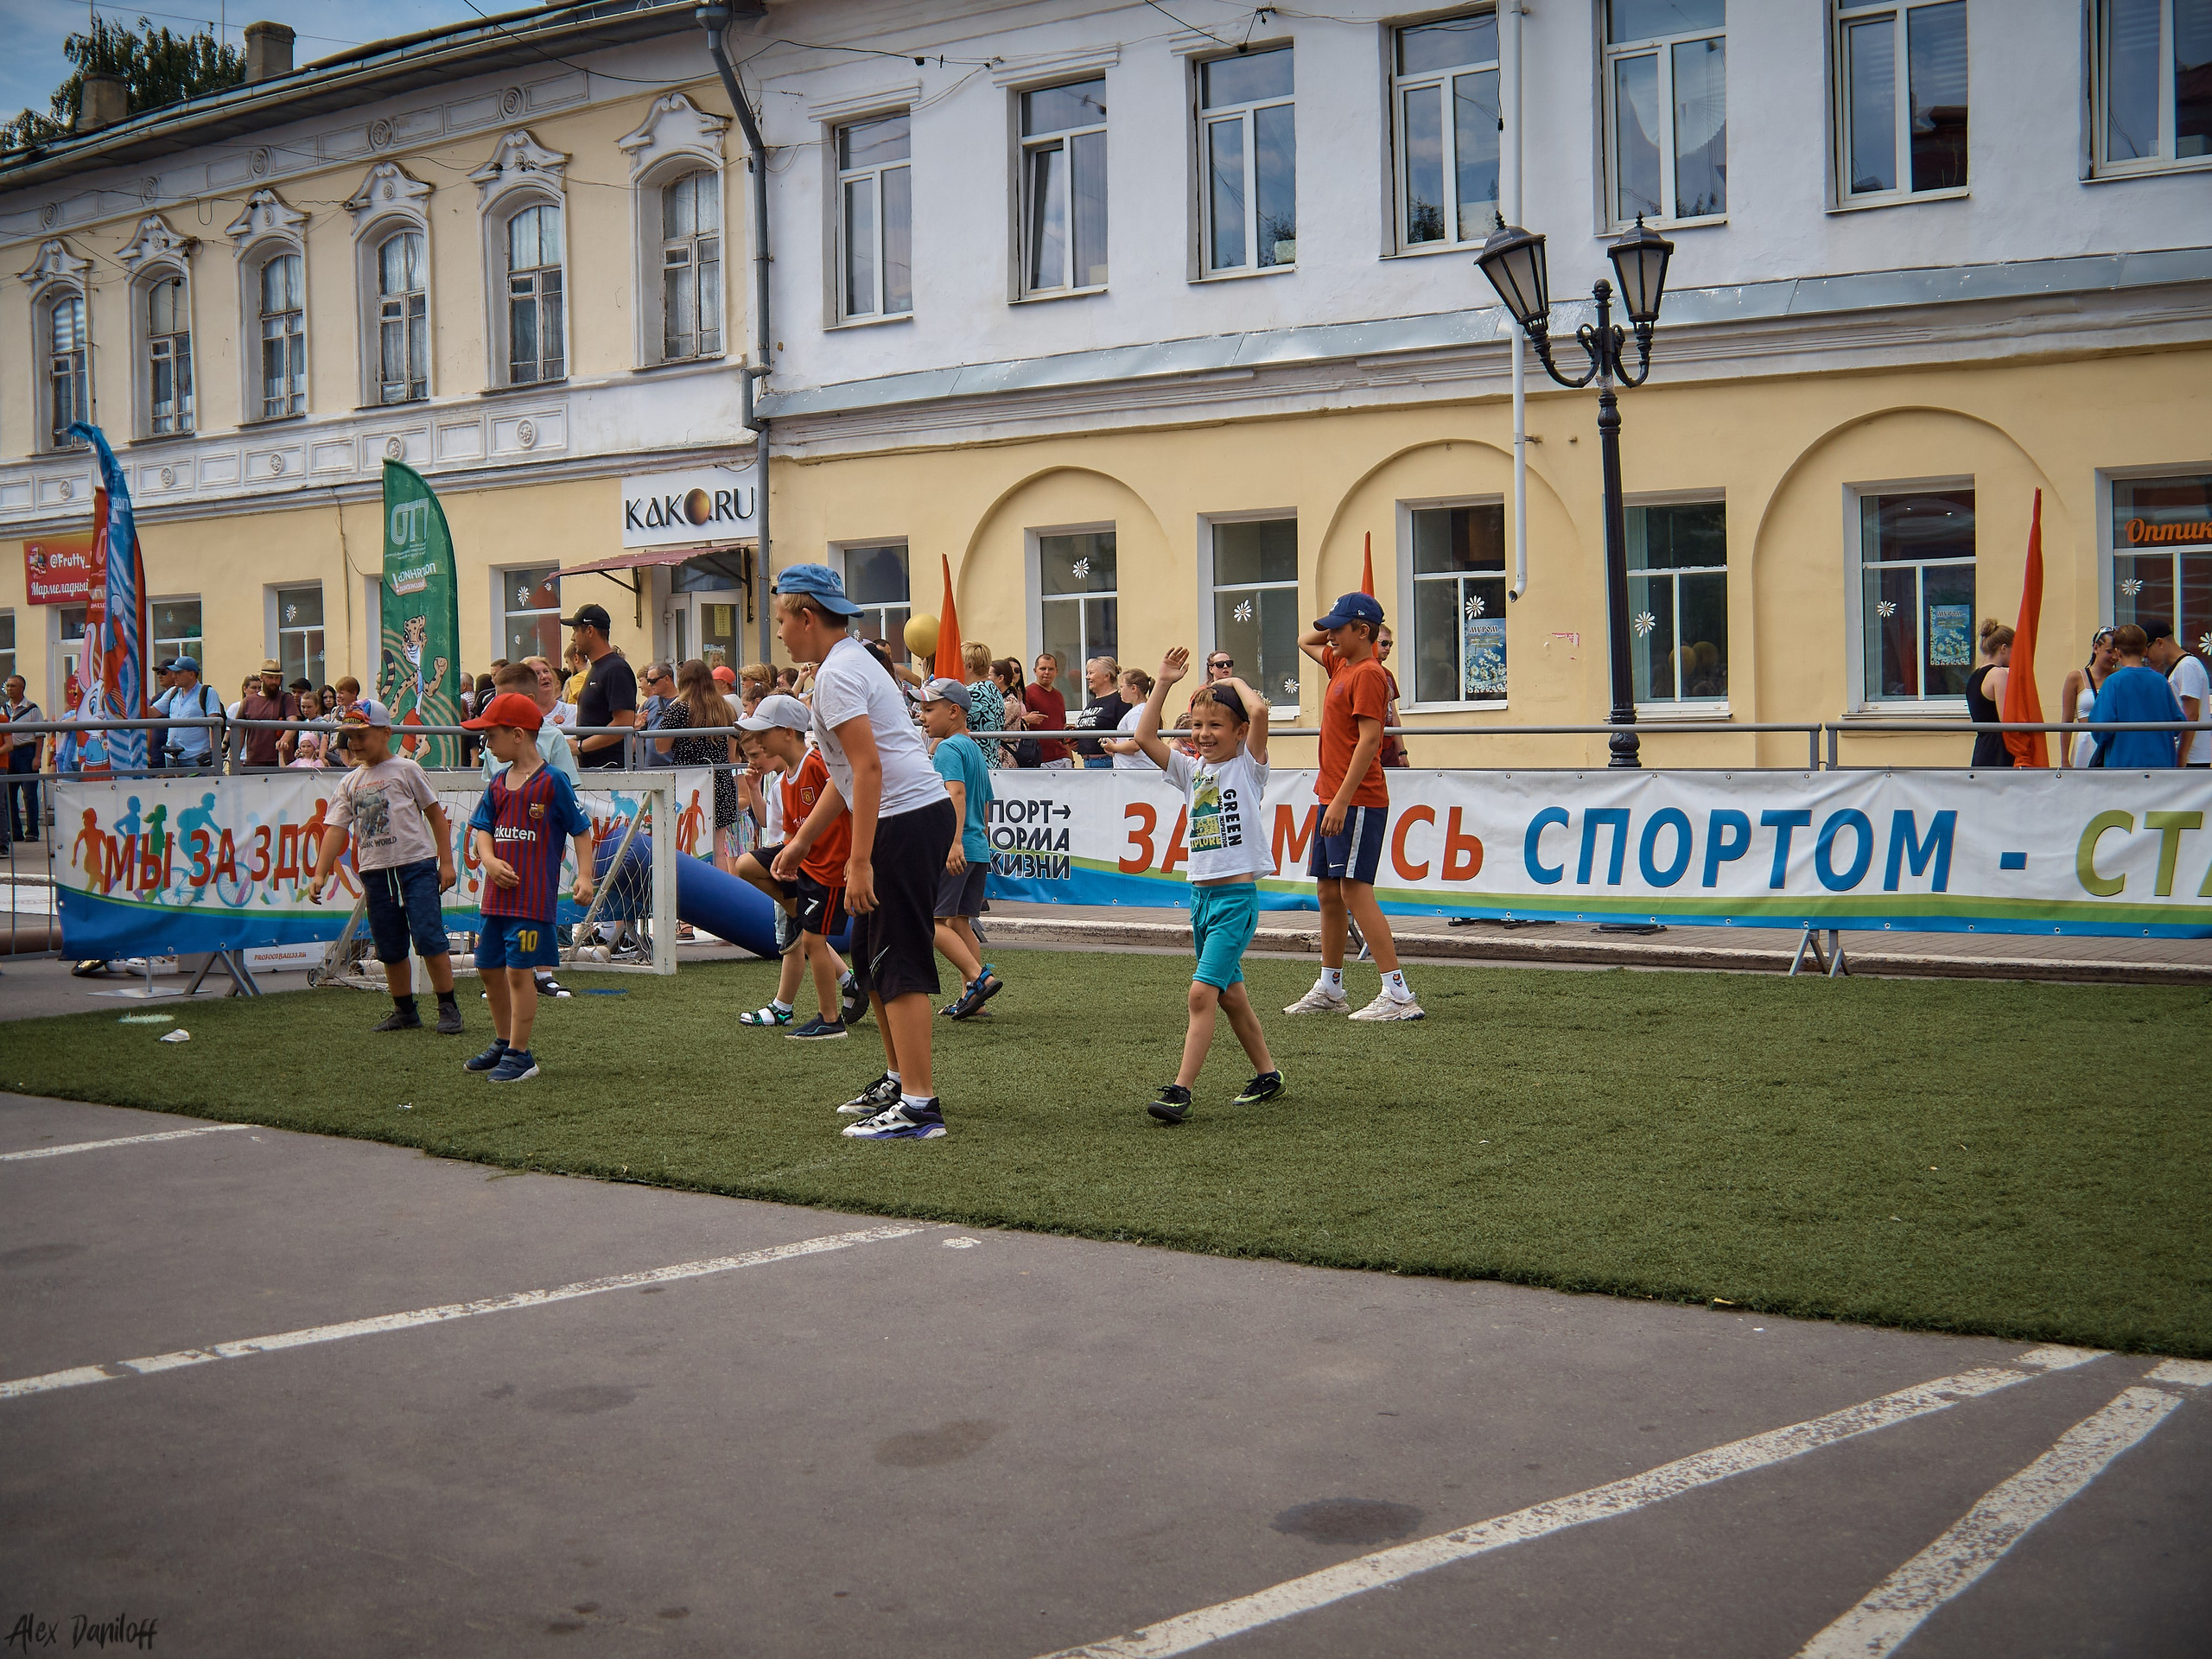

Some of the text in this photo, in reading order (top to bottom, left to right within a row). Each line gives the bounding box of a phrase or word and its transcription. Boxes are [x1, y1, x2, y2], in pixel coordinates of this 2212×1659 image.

[2125, 518, 2212, 543] Оптик
[50, 550, 92, 569] @Frutty_
[988, 799, 1053, 823] ПОРТ
[1223, 788, 1243, 847] GREEN
[493, 824, 537, 842] akuten
[1219, 815, 1228, 849] INSPIRATION
[103, 831, 173, 893] МЫ
[188, 828, 238, 887] ЗА
[1118, 802, 1484, 881] ЗАМСЬ
[1522, 804, 1959, 893] СПОРТОМ
[2074, 809, 2212, 898] СТ
[518, 930, 538, 952] 10
